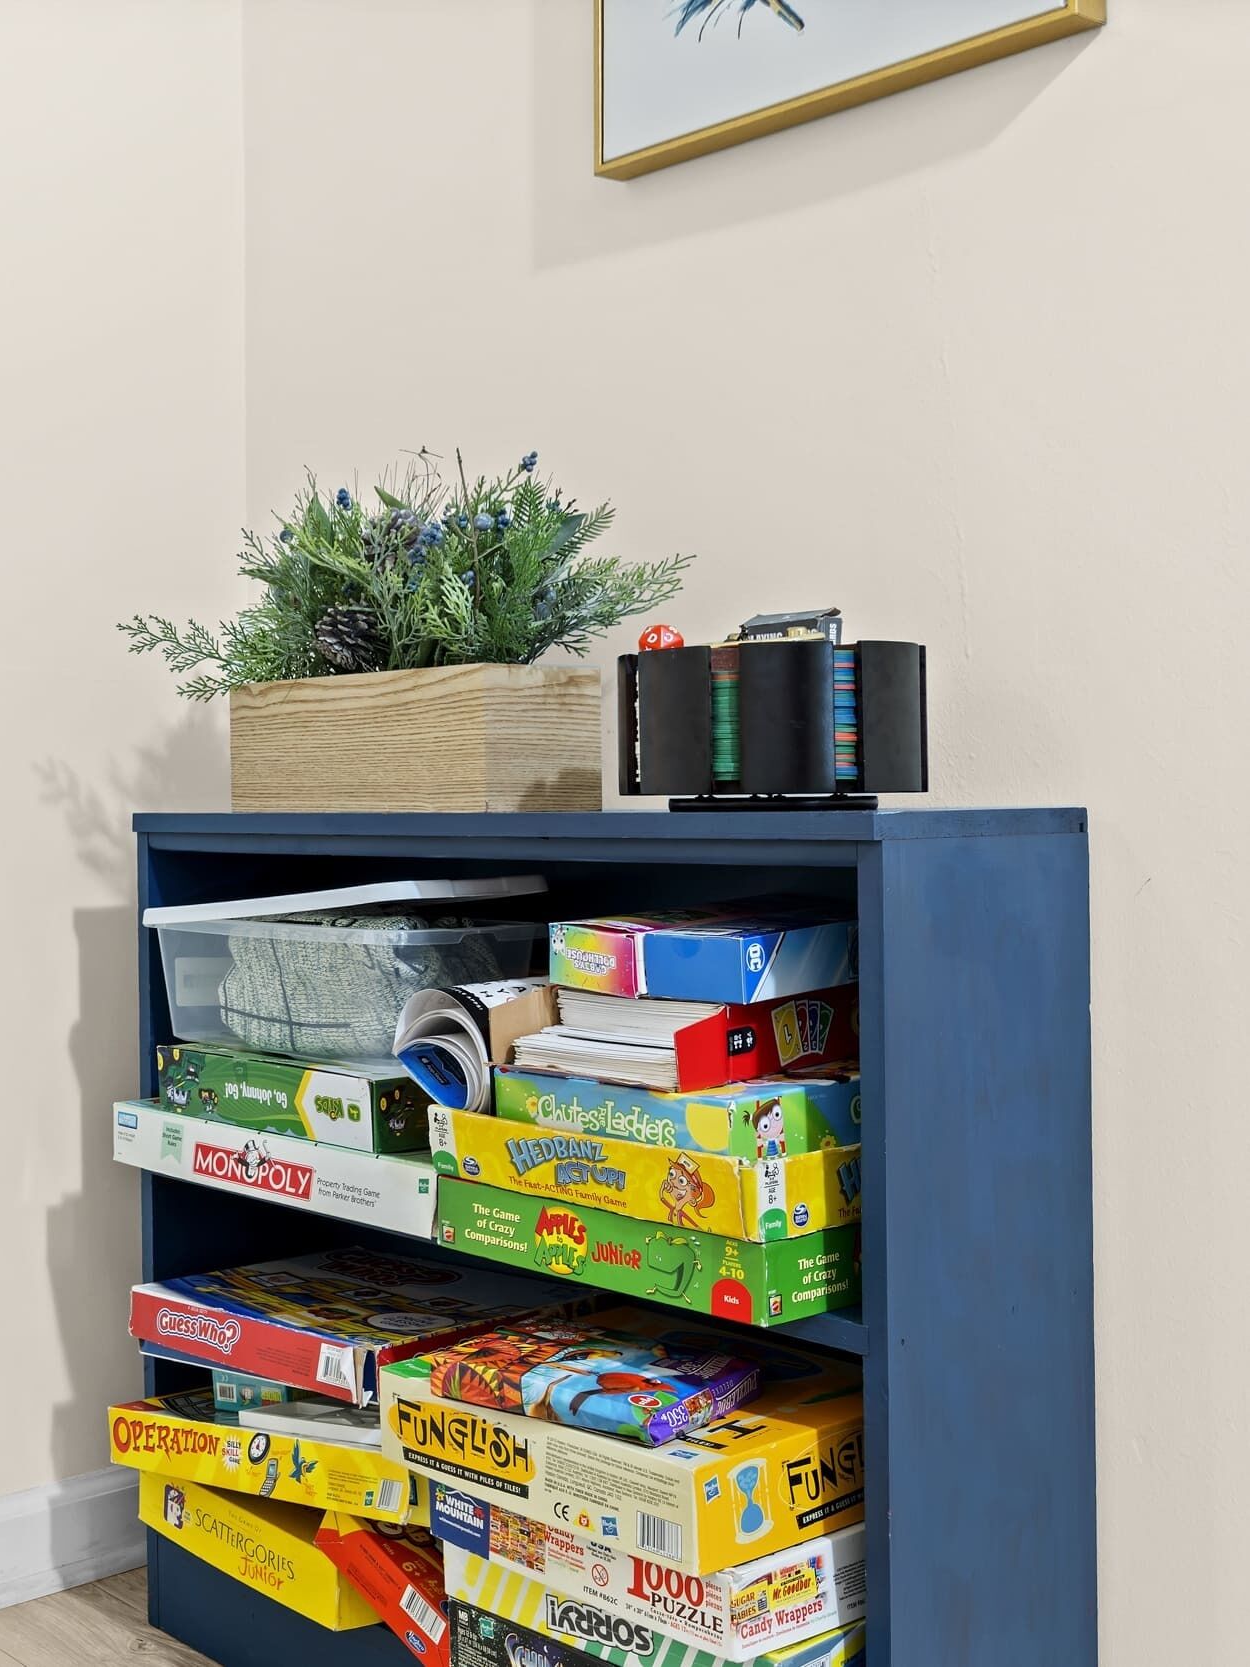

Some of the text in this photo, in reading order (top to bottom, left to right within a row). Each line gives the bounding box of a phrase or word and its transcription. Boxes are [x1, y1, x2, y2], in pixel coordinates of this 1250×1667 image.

[749, 944, 763, 971] DC
[225, 1082, 239, 1099] Go!
[538, 1094, 601, 1131] Chutes
[605, 1101, 677, 1148] Ladders
[507, 1136, 608, 1176] HEDBANZ
[556, 1161, 626, 1191] ACT UP!
[317, 1178, 380, 1199] Property Trading Game
[318, 1188, 332, 1198] from
[333, 1191, 350, 1202] Parker
[508, 1175, 523, 1187] The
[575, 1189, 601, 1203] Family
[603, 1196, 627, 1208] Game
[473, 1203, 521, 1223] The Game
[765, 1220, 782, 1230] Family
[476, 1219, 515, 1238] of Crazy
[534, 1206, 588, 1245] APPLES
[464, 1229, 528, 1253] Comparisons!
[725, 1247, 739, 1257] 9+
[798, 1251, 840, 1270] The Game
[718, 1266, 745, 1280] 4-10
[802, 1267, 837, 1285] of Crazy
[723, 1294, 740, 1305] Kids
[791, 1279, 849, 1303] Comparisons!
[113, 1416, 220, 1463] OPERATION
[408, 1452, 428, 1464] EXPRESS
[429, 1458, 435, 1466] IT
[441, 1462, 456, 1474] GUESS
[457, 1467, 462, 1475] IT
[464, 1470, 478, 1480] WITH
[479, 1475, 494, 1486] PILES
[504, 1482, 521, 1494] TILES!
[435, 1501, 484, 1529] MOUNTAIN
[445, 1494, 474, 1515] WHITE
[802, 1509, 824, 1524] EXPRESS
[195, 1508, 295, 1581] SCATTERGORIES
[544, 1532, 585, 1556] Wrappers
[583, 1586, 598, 1597] ITEM
[627, 1555, 704, 1607] 1000
[783, 1578, 811, 1596] Goodbar
[730, 1592, 755, 1608] SUGAR
[650, 1592, 724, 1633] PUZZLE
[730, 1606, 757, 1622] BABIES
[740, 1615, 772, 1640] Candy
[775, 1600, 823, 1627] Wrappers
[549, 1599, 651, 1652] SORRY!
